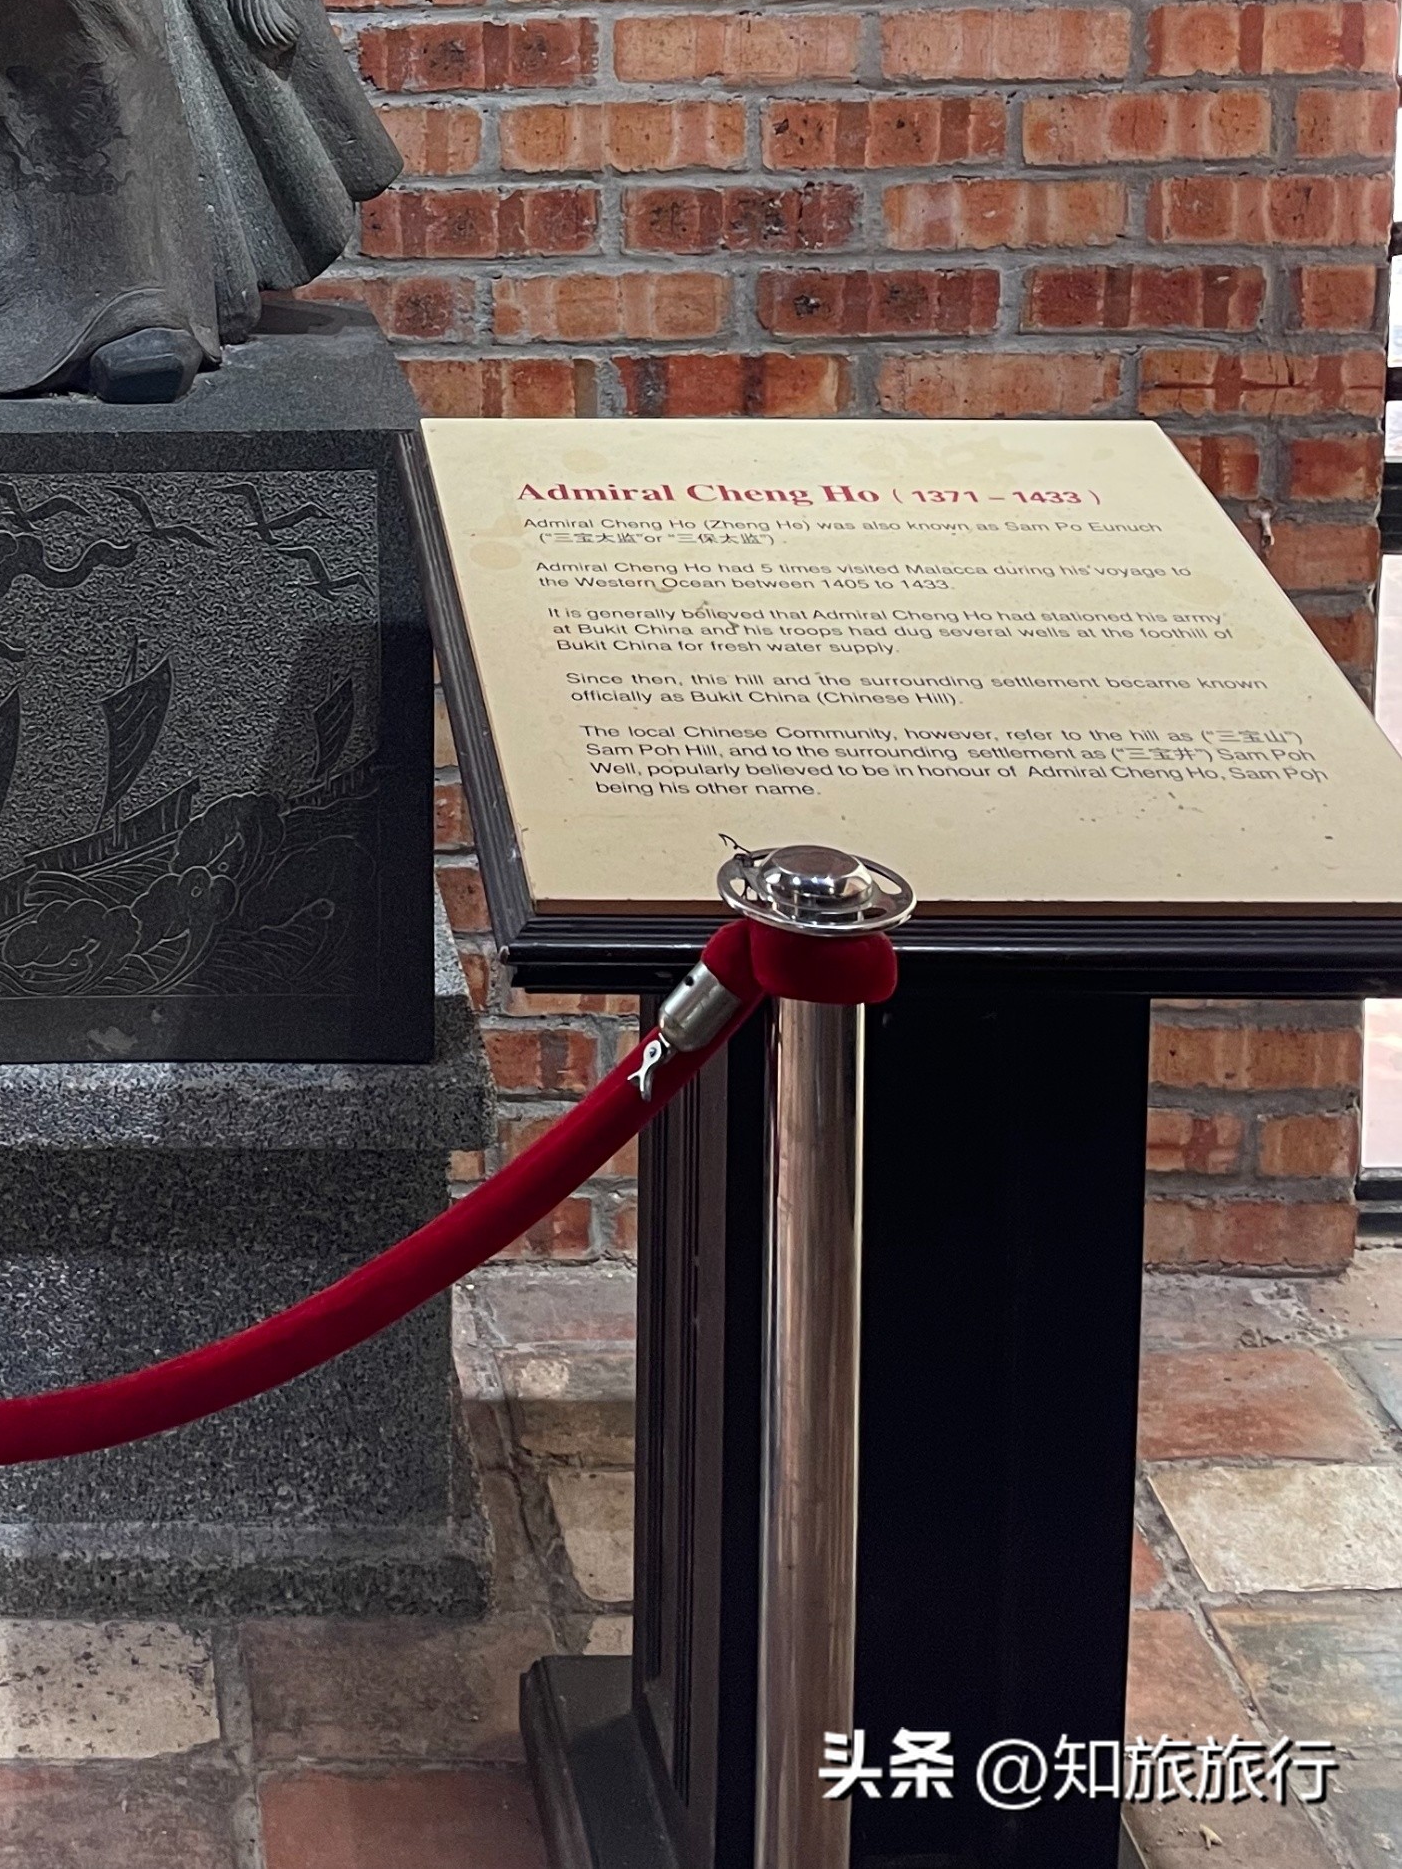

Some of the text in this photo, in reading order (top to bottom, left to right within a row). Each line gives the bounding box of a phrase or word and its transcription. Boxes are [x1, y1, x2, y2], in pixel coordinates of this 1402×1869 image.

[518, 484, 674, 501] Admiral
[687, 485, 813, 506] Cheng
[821, 486, 879, 502] Ho
[524, 519, 593, 528] Admiral
[601, 519, 662, 531] Cheng
[669, 520, 696, 529] Ho
[704, 520, 770, 531] (Zheng
[817, 522, 855, 530] was
[863, 521, 901, 530] also
[906, 521, 972, 531] known
[1004, 522, 1050, 531] Sam
[1054, 522, 1082, 531] Po
[1088, 522, 1162, 532] Eunuch
[536, 562, 1191, 578] Admiral Cheng Ho had 5 times visited Malacca during his voyage to
[539, 577, 954, 589] the Western Ocean between 1405 to 1433.
[548, 608, 1220, 625] It is generally believed that Admiral Cheng Ho had stationed his army
[553, 624, 1233, 639] at Bukit China and his troops had dug several wells at the foothill of
[557, 640, 899, 655] Bukit China for fresh water supply.
[566, 673, 1267, 689] Since then, this hill and the surrounding settlement became known
[571, 690, 963, 706] officially as Bukit China (Chinese Hill).
[580, 726, 619, 737] The
[628, 726, 675, 737] local
[684, 726, 767, 738] Chinese
[776, 727, 897, 742] Community,
[904, 728, 998, 741] however,
[1006, 729, 1052, 740] refer
[1061, 730, 1081, 741] to
[1089, 730, 1122, 741] the
[1129, 730, 1159, 741] hill
[1167, 732, 1193, 742] as
[586, 743, 633, 755] Sam
[639, 744, 680, 756] Poh
[685, 745, 723, 758] Hill,
[729, 745, 767, 756] and
[772, 746, 791, 757] to
[796, 745, 829, 757] the
[835, 746, 958, 761] surrounding
[968, 747, 1076, 759] settlement
[1081, 750, 1106, 759] as
[1216, 748, 1270, 761] Sam
[1270, 749, 1316, 761] Poh
[590, 762, 1328, 782] Well, popularly believed to be in honour of Admiral Cheng Ho, Sam Poh
[596, 781, 820, 796] being his other name.
